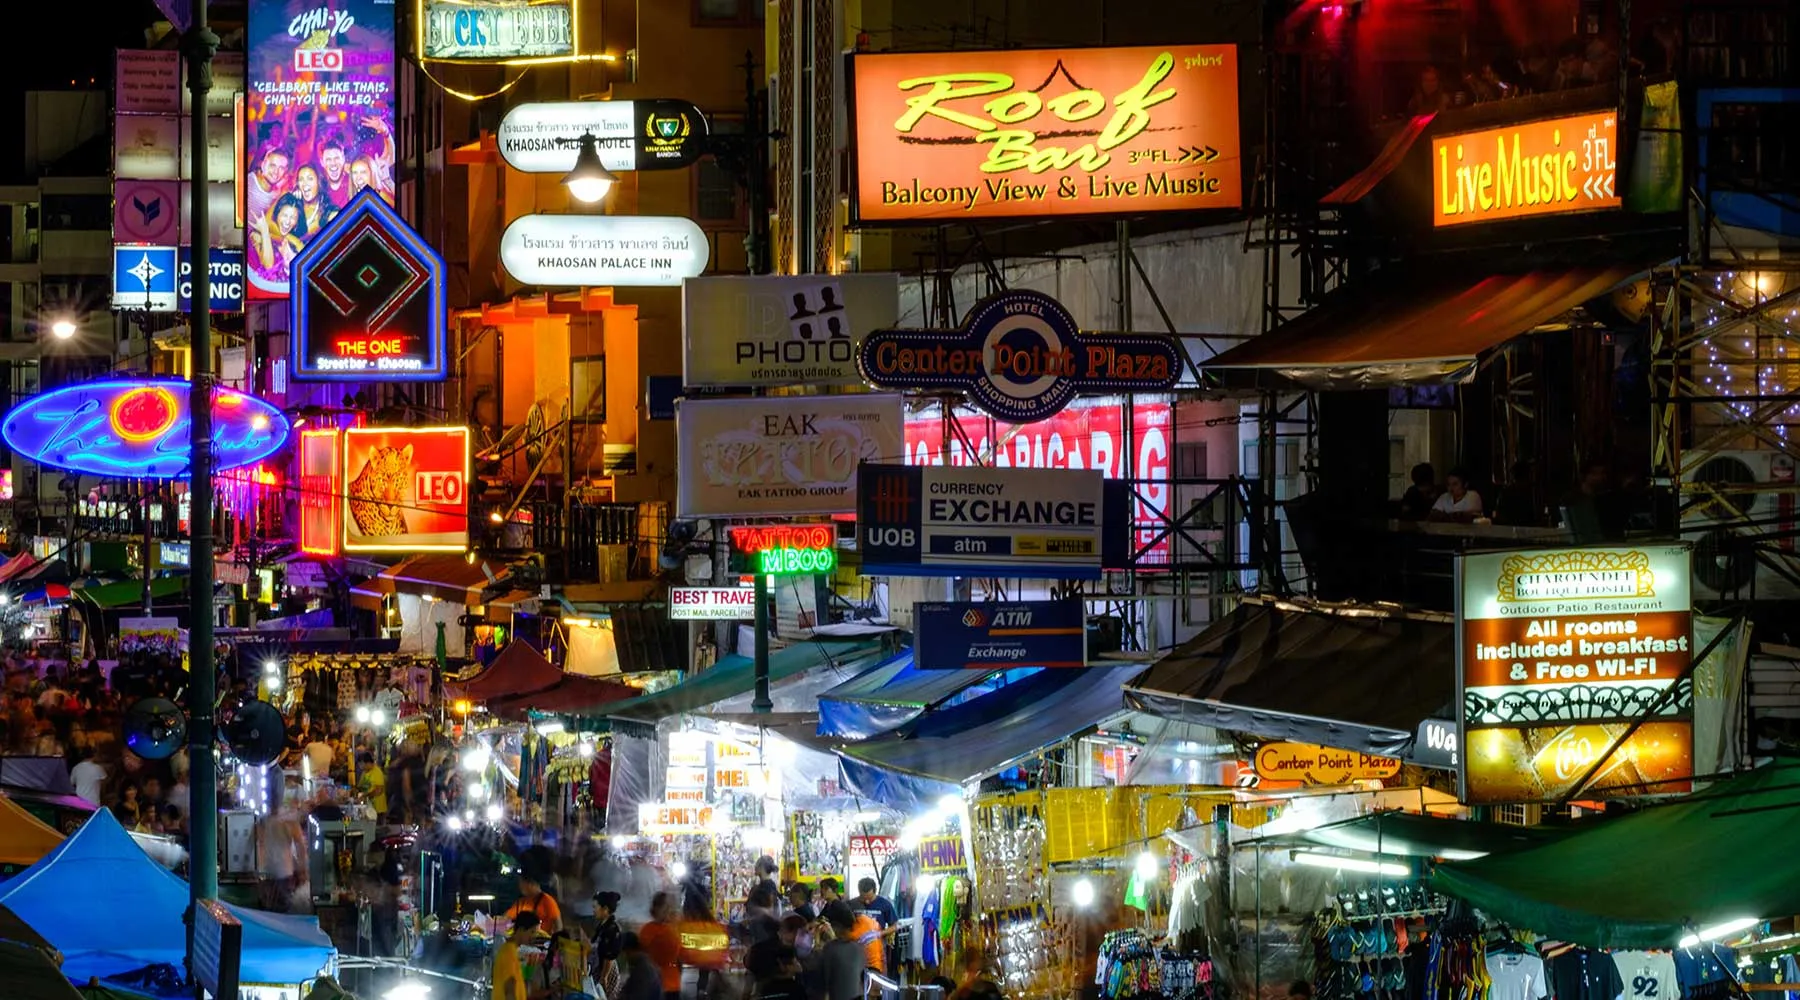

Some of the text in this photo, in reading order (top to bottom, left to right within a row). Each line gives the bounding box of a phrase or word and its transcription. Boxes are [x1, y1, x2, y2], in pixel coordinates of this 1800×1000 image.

[288, 7, 354, 39] CHAI-YO
[425, 7, 571, 46] LUCKY BEER
[298, 52, 340, 68] LEO
[325, 82, 349, 92] LIKE
[319, 94, 345, 105] WITH
[894, 51, 1177, 150] Roof
[663, 123, 672, 133] K
[506, 137, 554, 152] KHAOSAN
[975, 129, 1111, 174] Bar
[1439, 129, 1578, 216] Live Music
[881, 171, 1221, 211] Balcony View & Live Music
[522, 234, 564, 249] โรงแรม
[181, 262, 242, 276] DTOR
[538, 257, 672, 269] KHAOSAN PALACE INN
[181, 282, 242, 299] CNIC
[1004, 303, 1046, 317] HOTEL
[337, 340, 401, 354] THE ONE
[736, 339, 851, 364] PHOTO
[378, 357, 422, 369] Khaosan
[876, 341, 1169, 379] Center Point Plaza
[978, 376, 1071, 410] SHOPPING MALL
[35, 399, 121, 458] The
[763, 414, 820, 437] EAK
[418, 474, 460, 500] LEO
[738, 486, 848, 499] EAK TATTOO GROUP
[929, 483, 1004, 495] CURRENCY
[929, 499, 1096, 525] EXCHANGE
[733, 527, 830, 551] TATTOO
[868, 528, 916, 547] UOB
[954, 537, 987, 553] atm
[673, 590, 755, 605] BEST TRAVE
[710, 608, 738, 617] PARCEL
[1500, 601, 1663, 616] Outdoor Patio Restaurant
[992, 611, 1032, 626] ATM
[1526, 619, 1637, 638] All rooms
[968, 647, 1027, 660] Exchange
[1476, 635, 1688, 661] included breakfast
[1510, 663, 1528, 680] &
[1536, 661, 1589, 678] Free
[1426, 725, 1457, 752] Wa
[1261, 749, 1396, 772] Center Point Plaza
[667, 790, 704, 801] HENNA
[851, 838, 899, 848] SIAM
[922, 839, 967, 867] HENNA
[1632, 975, 1658, 997] 92
